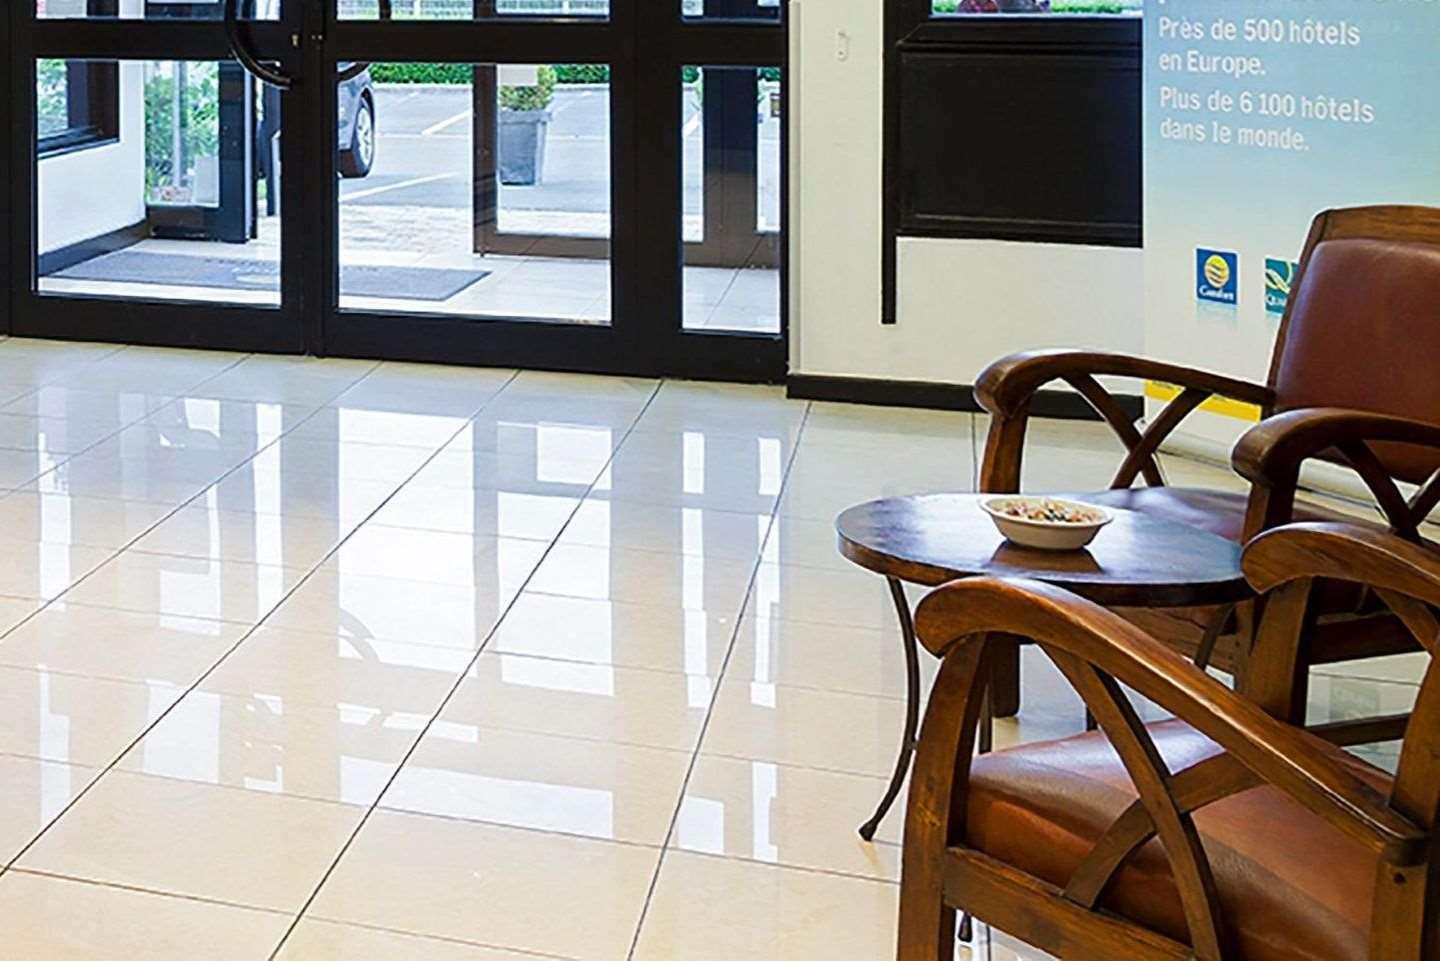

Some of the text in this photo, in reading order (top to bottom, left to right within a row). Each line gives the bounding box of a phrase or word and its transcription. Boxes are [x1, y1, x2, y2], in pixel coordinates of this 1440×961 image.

[1159, 17, 1360, 45] Près de 500 hôtels
[1158, 51, 1266, 78] en Europe.
[1159, 86, 1374, 123] Plus de 6 100 hôtels
[1160, 119, 1309, 150] dans le monde.
